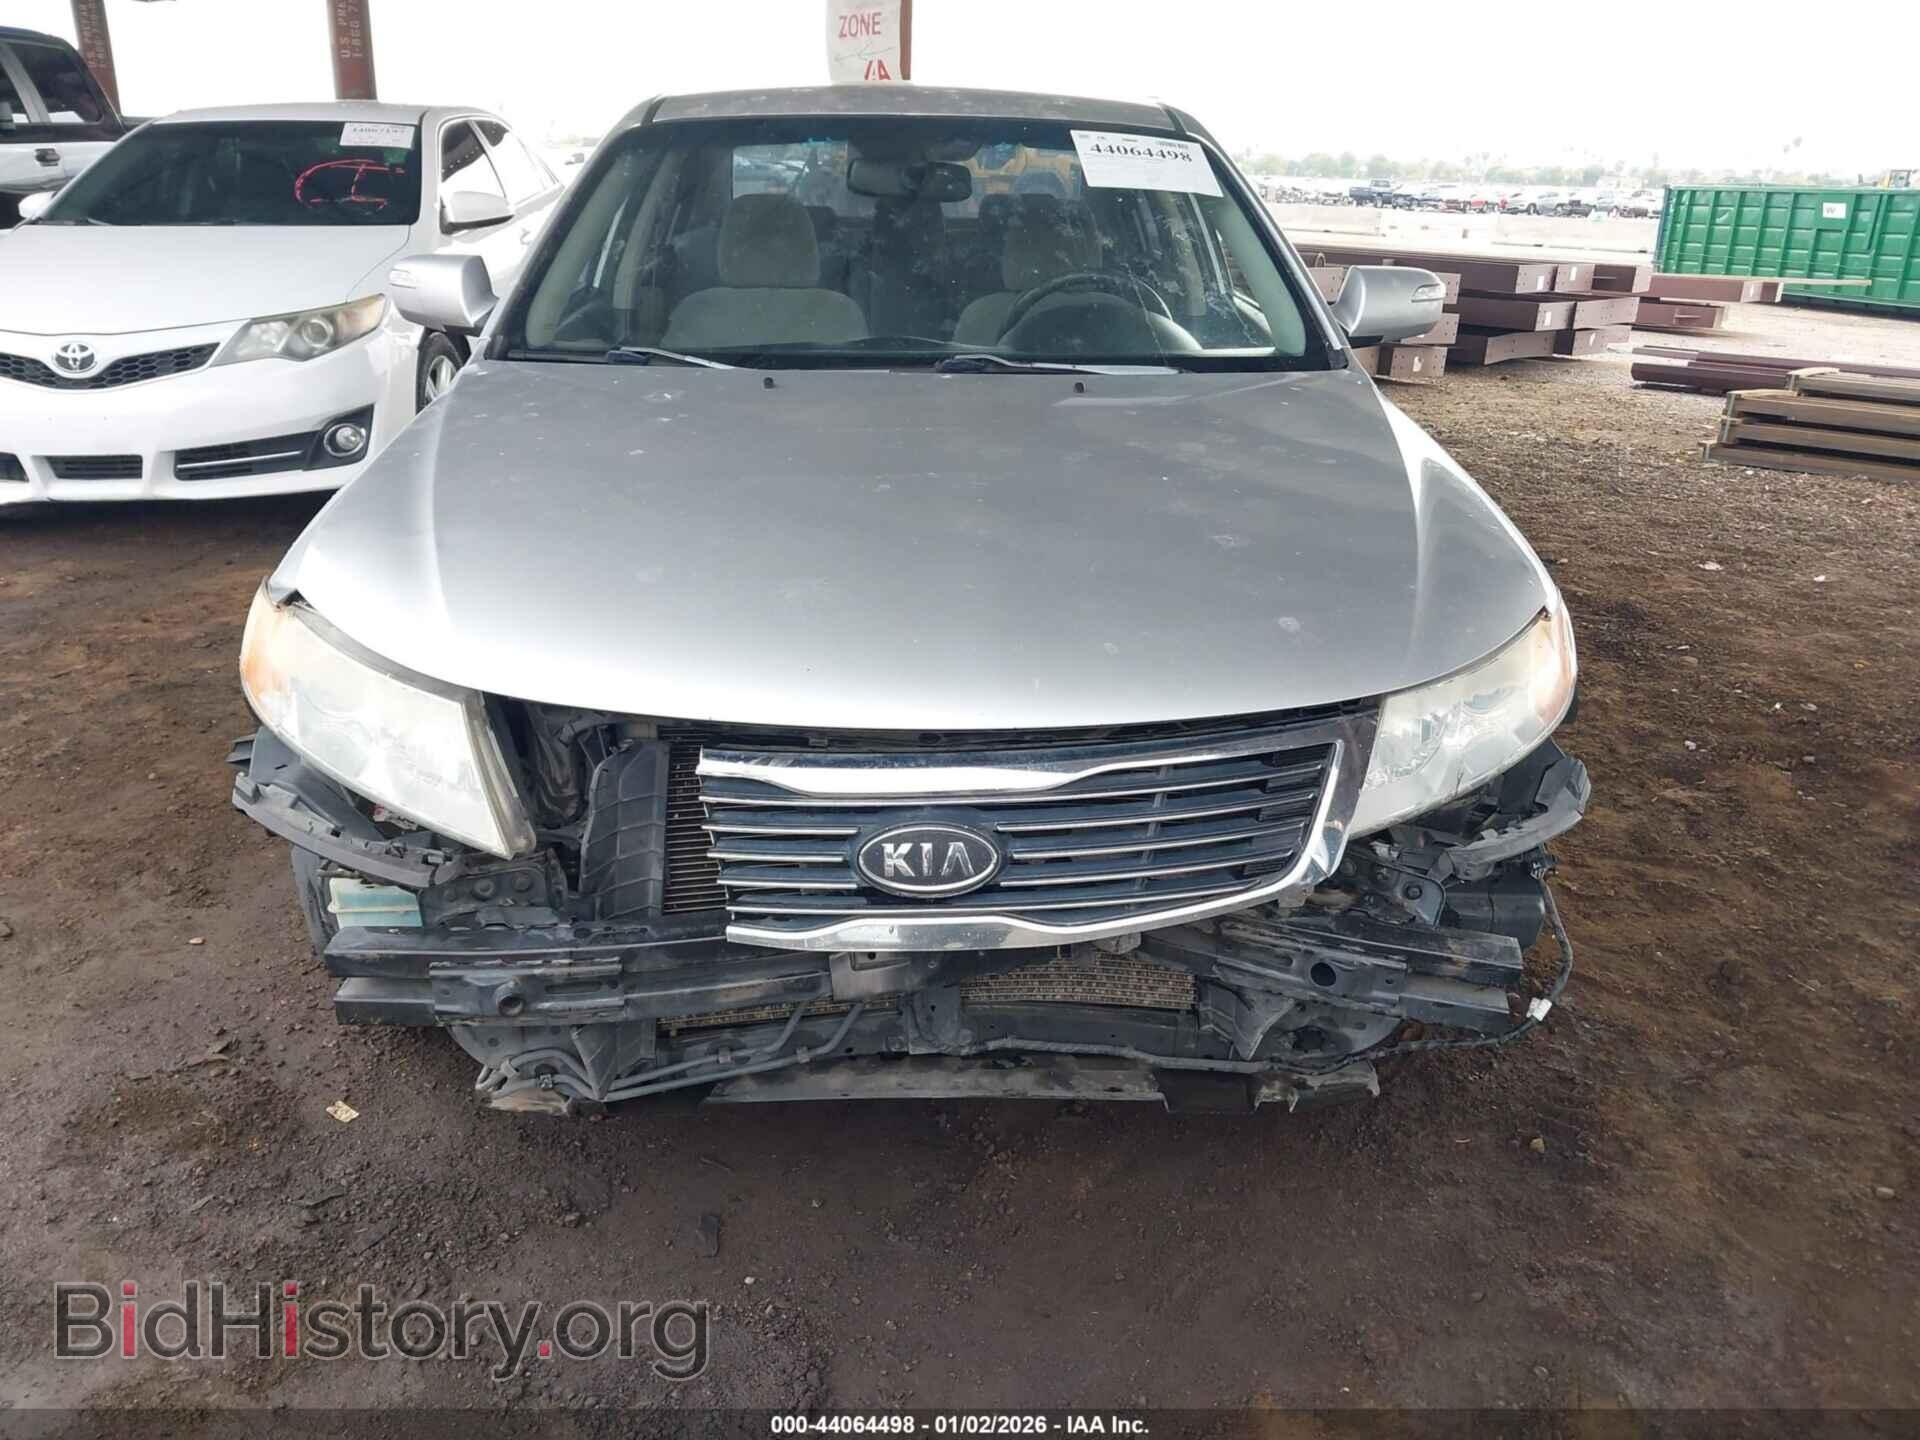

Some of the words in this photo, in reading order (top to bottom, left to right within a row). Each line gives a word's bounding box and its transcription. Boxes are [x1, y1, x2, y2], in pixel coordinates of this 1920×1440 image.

[838, 12, 882, 38] ZONE
[1090, 143, 1192, 162] 44064498
[881, 842, 975, 877] KIA
